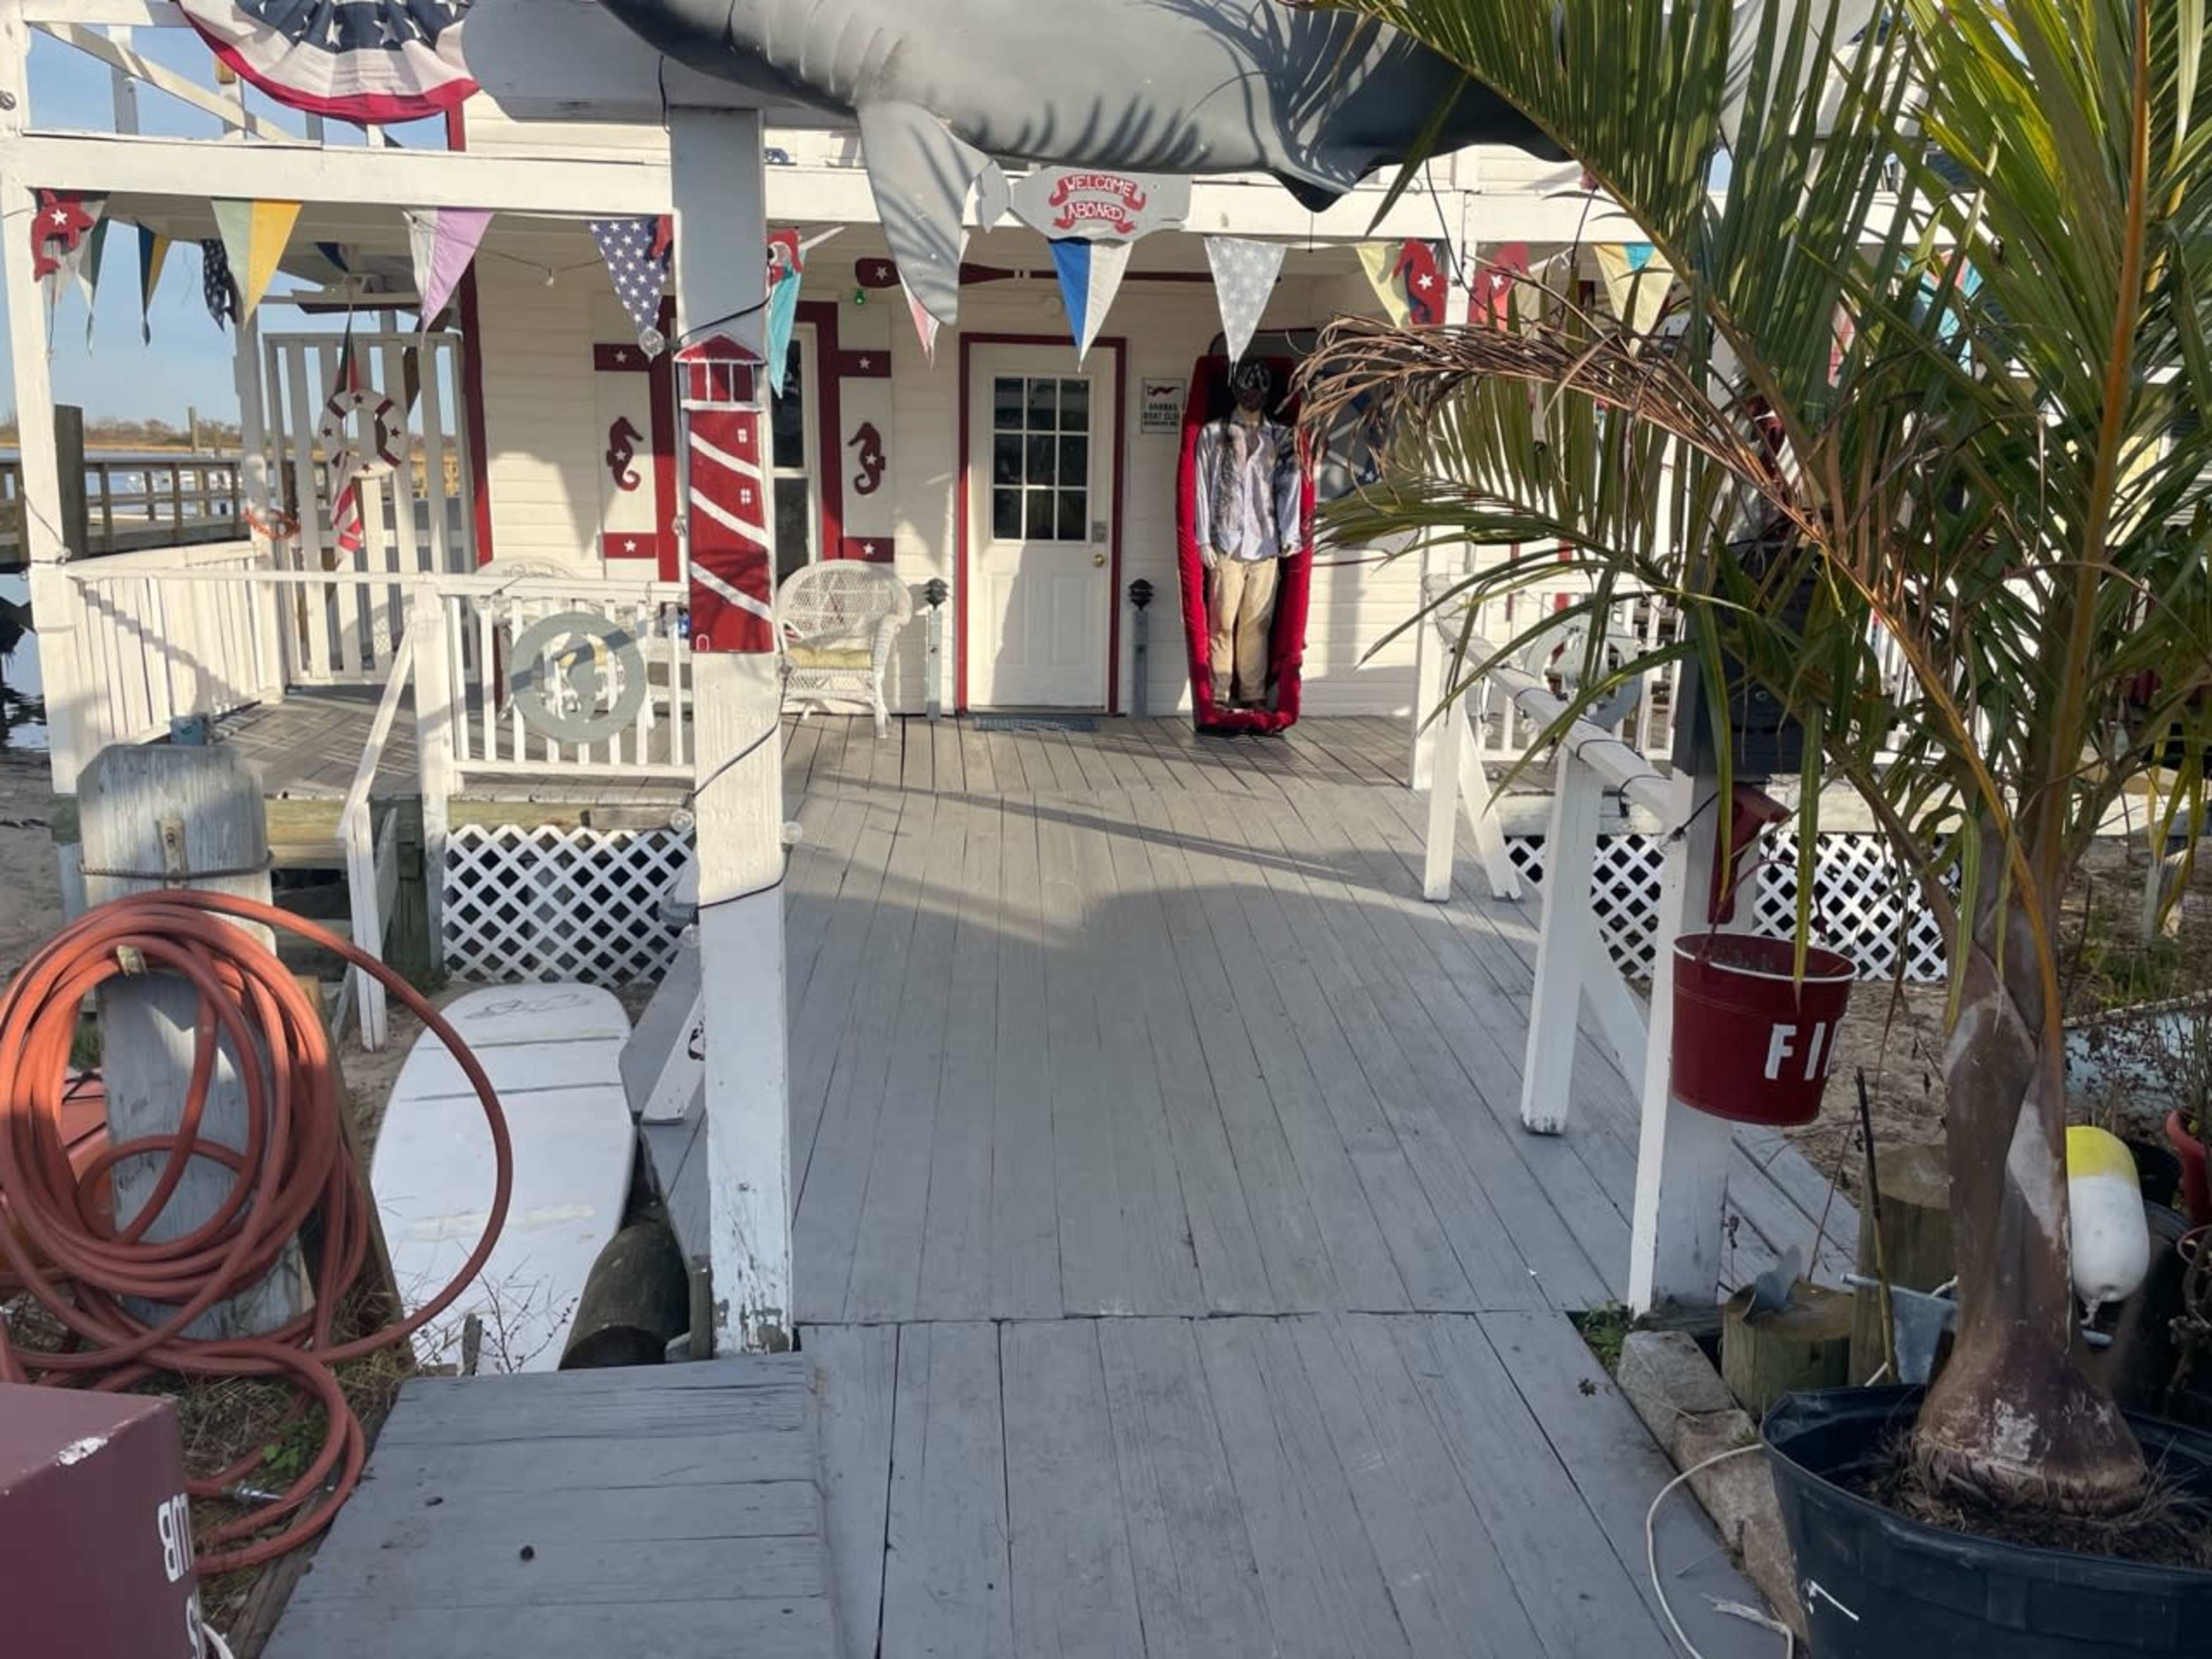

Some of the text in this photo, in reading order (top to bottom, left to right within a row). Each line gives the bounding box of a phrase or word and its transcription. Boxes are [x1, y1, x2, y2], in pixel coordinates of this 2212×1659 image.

[1064, 175, 1134, 196] WELCOME
[1067, 202, 1123, 220] ABOARD
[1764, 1021, 1840, 1081] FI
